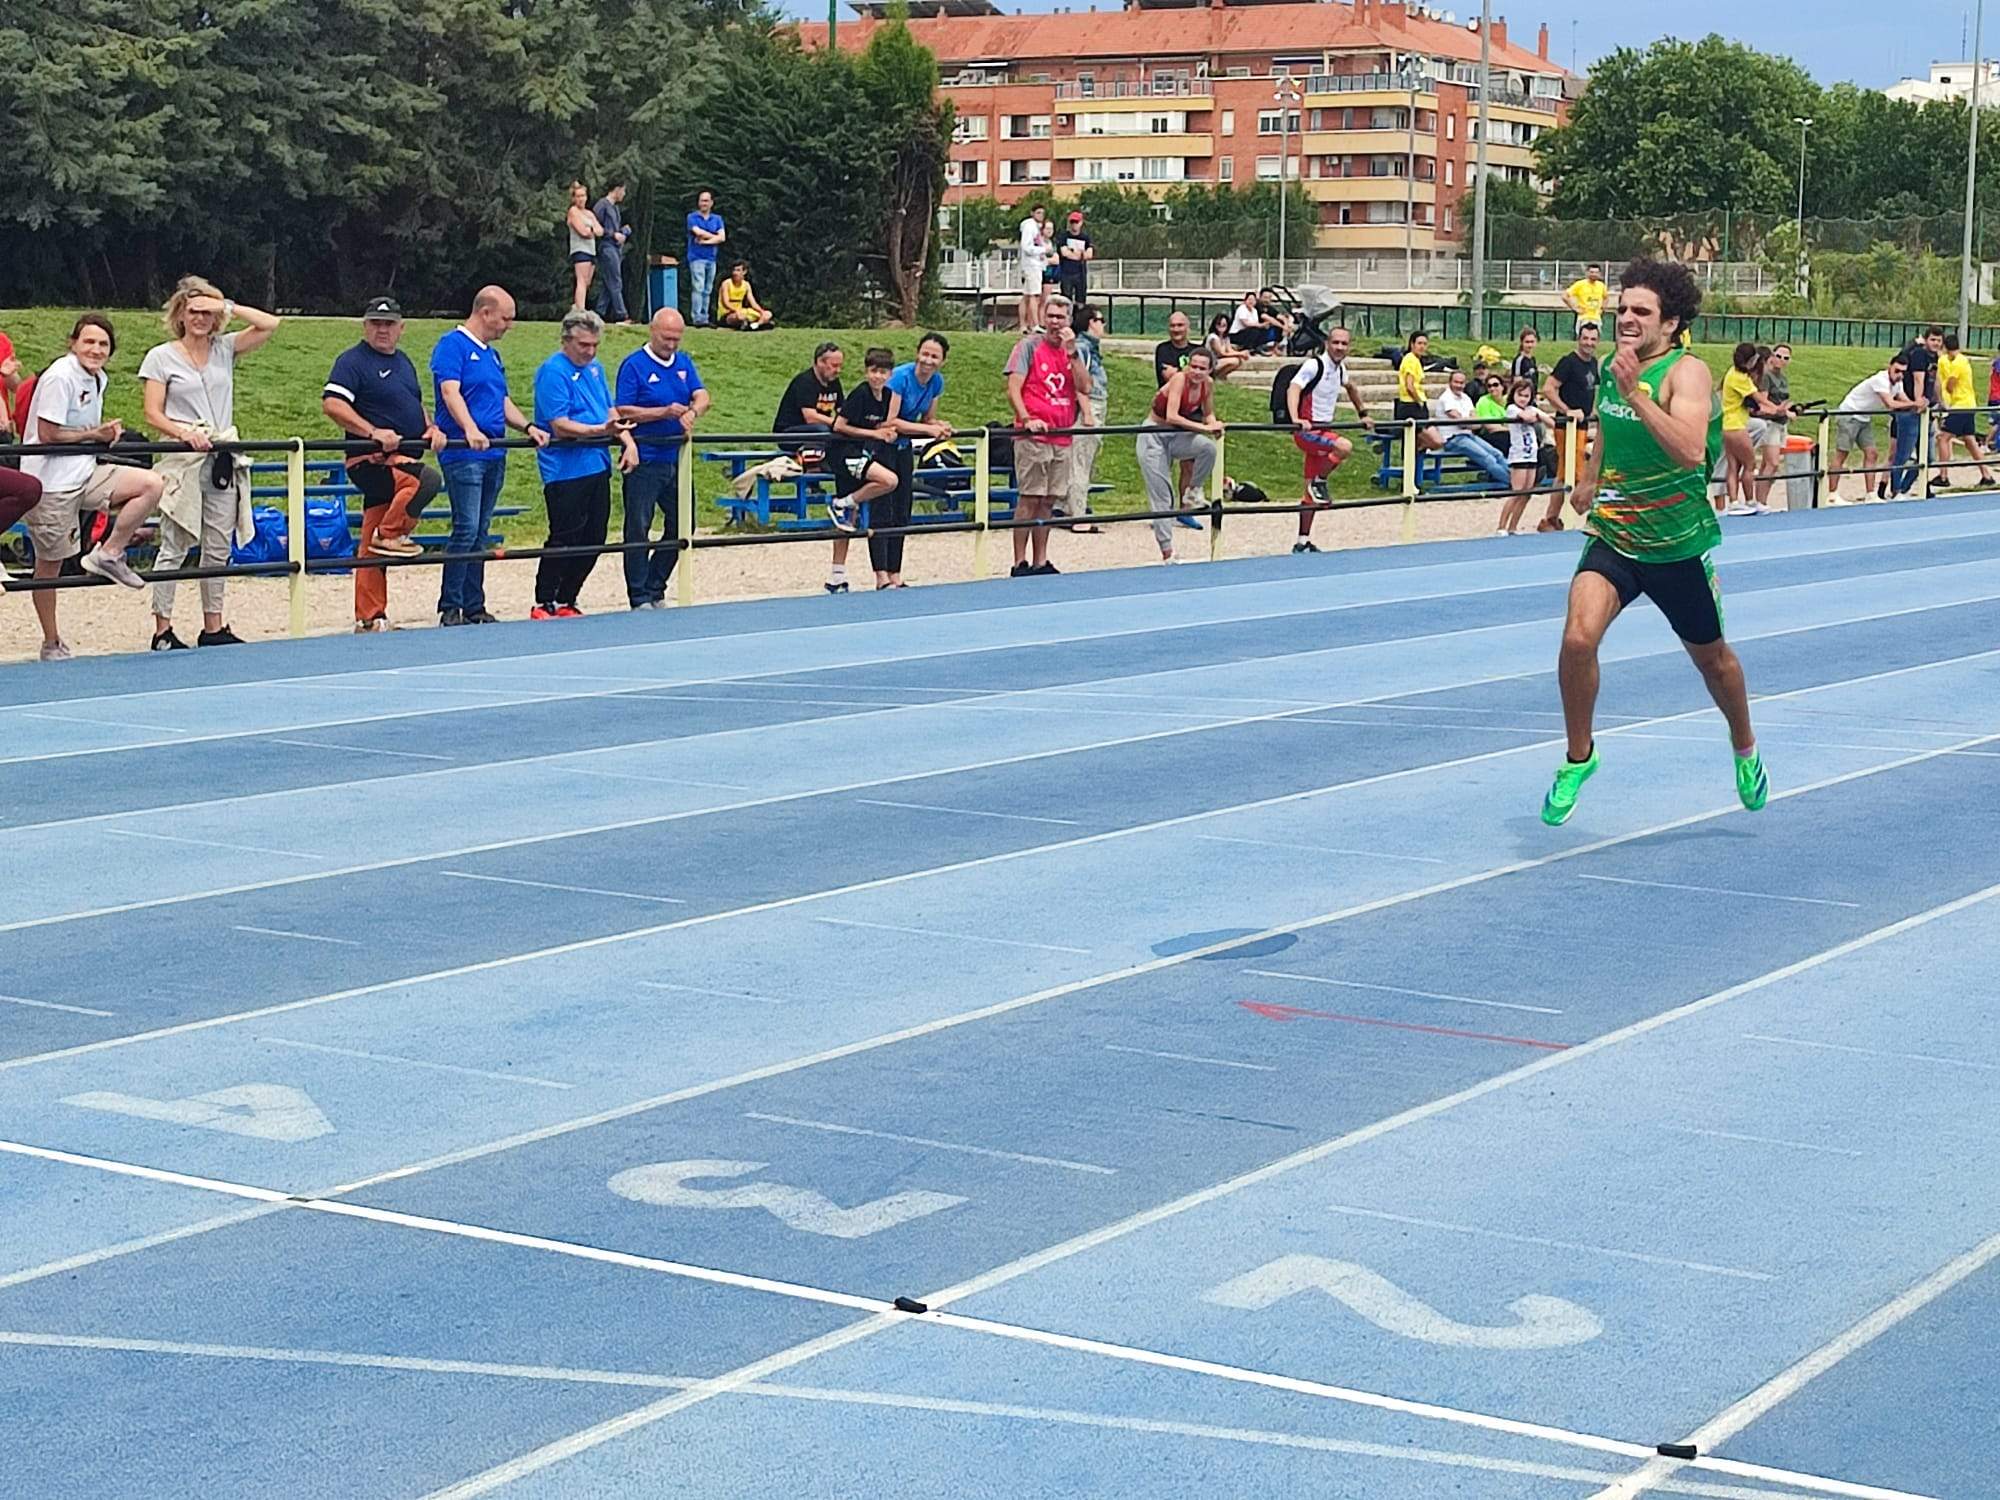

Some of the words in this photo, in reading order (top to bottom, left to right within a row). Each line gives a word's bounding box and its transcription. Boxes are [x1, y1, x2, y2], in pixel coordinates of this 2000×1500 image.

[60, 1083, 336, 1142] 4
[607, 1159, 968, 1238] 3
[1203, 1253, 1603, 1349] 2
